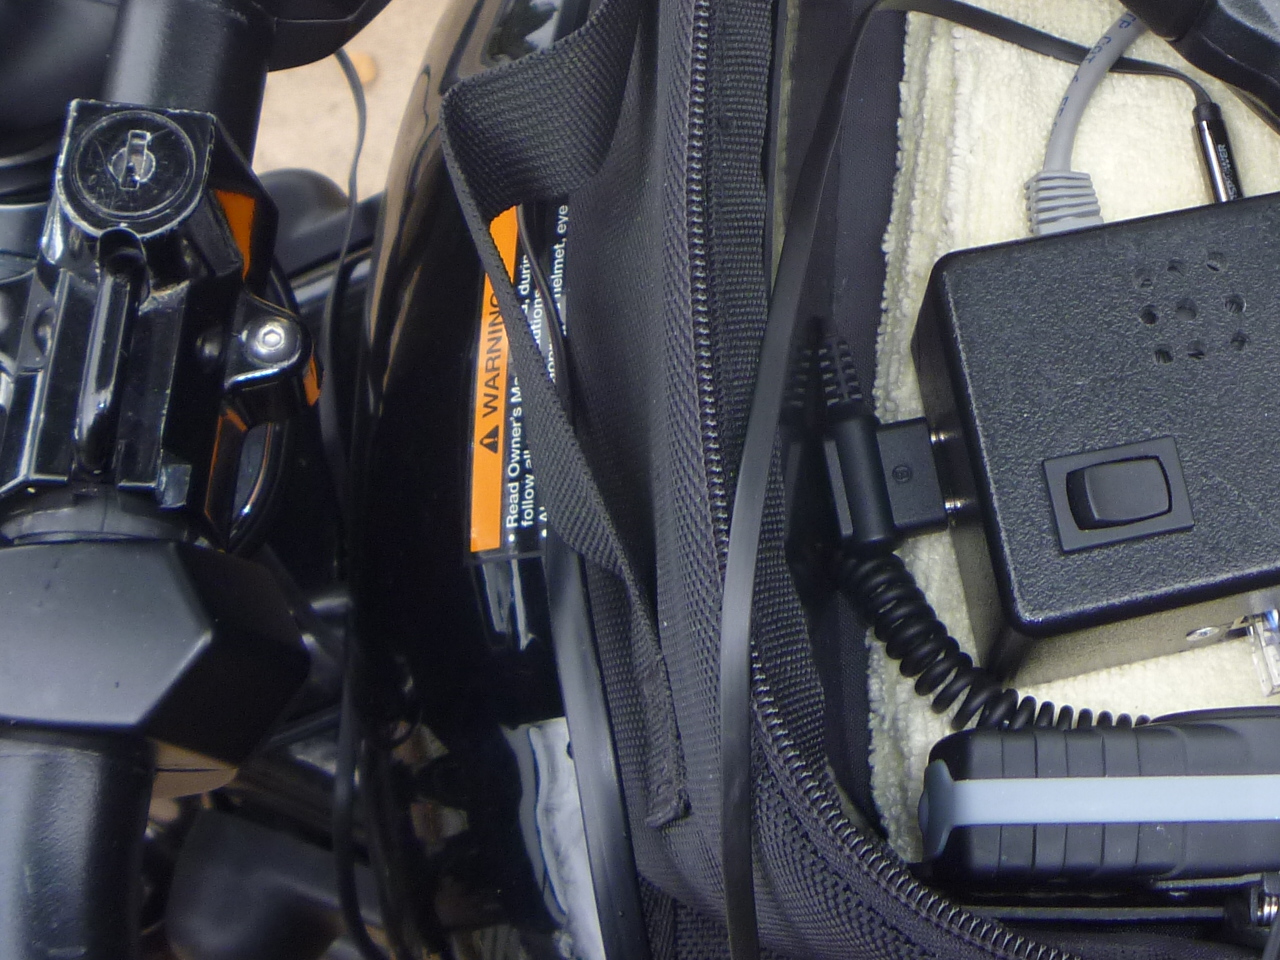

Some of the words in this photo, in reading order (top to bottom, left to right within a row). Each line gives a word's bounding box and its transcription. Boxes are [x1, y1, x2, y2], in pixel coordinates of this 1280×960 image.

[556, 204, 570, 235] eye
[518, 253, 531, 296] durin
[508, 406, 523, 478] Owner's
[506, 482, 520, 528] Read
[521, 474, 535, 528] follow
